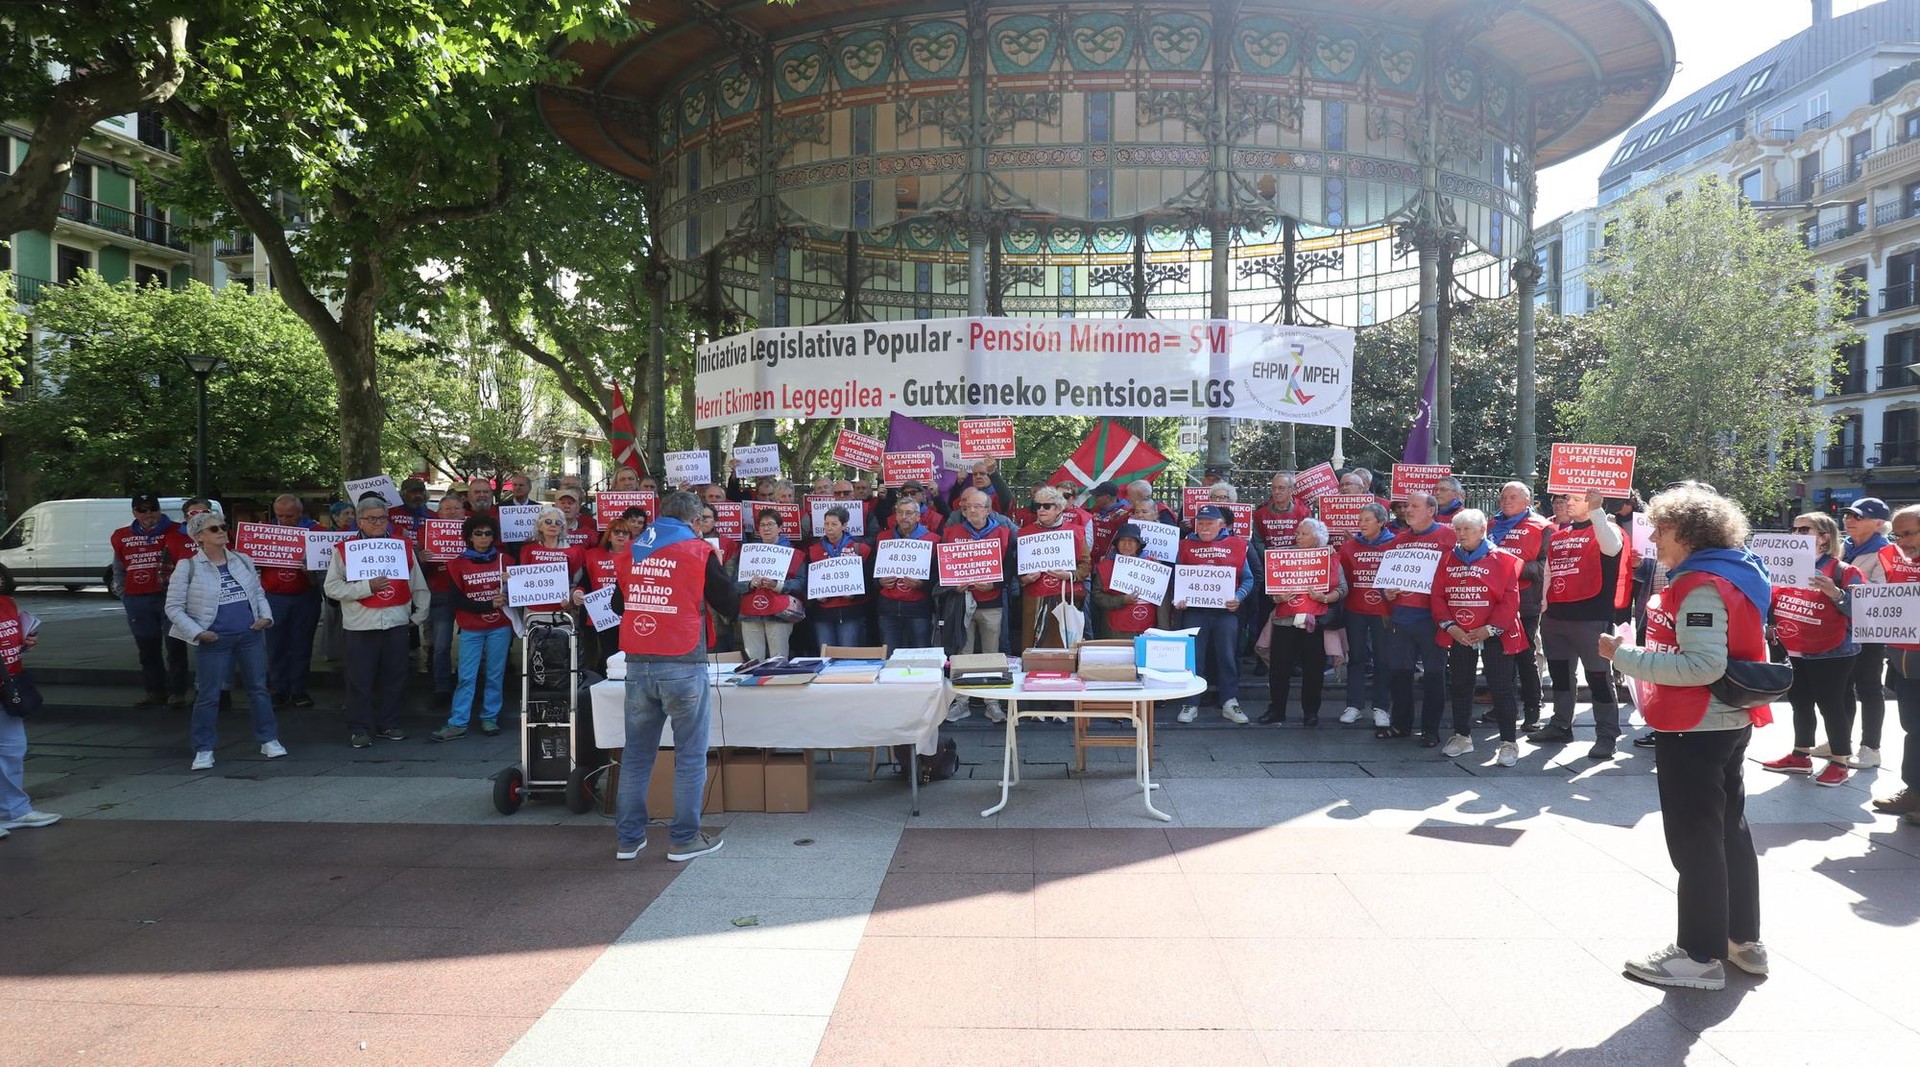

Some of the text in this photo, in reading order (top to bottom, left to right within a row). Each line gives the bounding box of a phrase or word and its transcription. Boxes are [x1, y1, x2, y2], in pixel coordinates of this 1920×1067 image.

[697, 340, 747, 374] Iniciativa
[750, 329, 857, 368] Legislativa
[863, 324, 953, 363] Popular
[969, 321, 1062, 357] Pensión
[1252, 362, 1340, 384] EHPM MPEH
[696, 397, 723, 421] Herri
[726, 388, 775, 415] Ekimen
[782, 379, 883, 416] Legegilea
[902, 375, 1047, 407] Gutxieneko
[962, 421, 1013, 429] GUTXIENEKO
[970, 427, 1007, 435] PENTSIOA
[843, 431, 884, 448] GUTXIENEKO
[965, 438, 1012, 446] GUTXIENEKO
[736, 446, 777, 455] GIPUZKOAN
[848, 439, 878, 452] PENTSIOA
[666, 452, 708, 462] GIPUZKOAN
[840, 446, 879, 461] GUTXIENEKO
[1558, 446, 1633, 457] GUTXIENEKO
[745, 456, 769, 464] 48.039
[844, 453, 872, 465] SOLDATA
[1569, 455, 1623, 465] PENTSIOA
[738, 467, 780, 475] SINADURAK
[1397, 466, 1451, 474] GUTXIENEKO
[1558, 468, 1628, 479] GUTXIENEKO
[347, 478, 389, 491] GIPUZKOA
[669, 474, 709, 484] SINADURAK
[1567, 476, 1616, 486] SOLDATA
[600, 493, 653, 501] GUTXIENEKO
[244, 525, 307, 537] GUTXIENEKO
[253, 533, 299, 543] PENTSIOA
[1019, 532, 1072, 545] GIPUZKOAN
[1143, 537, 1168, 547] 8.039
[244, 542, 303, 553] GUTXIENEKO
[349, 542, 403, 552] GIPUZKOA
[880, 541, 930, 550] GIPUZKOAN
[942, 541, 999, 553] GUTXIENEKO
[1752, 538, 1809, 551] GIPUZKOA
[251, 551, 294, 560] SOLDATA
[743, 545, 792, 557] GIPUZKOAN
[952, 548, 993, 559] PENTSIOA
[1031, 546, 1060, 555] 48.039
[1190, 547, 1231, 555] GUTXIENEKO
[1270, 550, 1328, 559] GUTXIENEKO
[1385, 550, 1439, 561] GIPUZKOAN
[361, 555, 396, 564] 48.039
[749, 557, 776, 565] 48.039
[888, 553, 917, 562] 48.039
[1280, 558, 1322, 566] PENTSIOA
[1763, 556, 1793, 567] 8.039
[509, 564, 566, 576] GIPUZKOAN
[810, 558, 860, 572] GIPUZKOAN
[945, 560, 999, 570] GUTXIENEKO
[1019, 559, 1074, 570] SINADURAK
[1117, 556, 1170, 576] GIPUZKOAN
[1391, 564, 1421, 573] 48.039
[359, 568, 400, 578] FIRMAS
[631, 564, 671, 578] MÍNIMA
[740, 570, 784, 580] SINADURAK
[820, 571, 849, 581] 48.039
[876, 566, 928, 577] SINADURAK
[953, 567, 992, 577] SOLDATA
[1179, 568, 1232, 579] GIPUZKOA
[1272, 569, 1326, 578] GUTXIENEKO
[523, 578, 554, 588] 48.039
[1127, 571, 1156, 585] 48.039
[1281, 576, 1319, 585] SOLDATA
[1375, 576, 1432, 590] SINADURAK
[628, 584, 673, 596] SALARIO
[809, 583, 862, 595] SINADURAK
[1112, 579, 1163, 602] SINADURAK
[1188, 583, 1221, 592] 48.039
[1854, 585, 1920, 599] GIPUZKOAN
[511, 592, 568, 604] SINADURAK
[628, 593, 669, 605] MÍNIMO
[1185, 596, 1224, 606] FIRMAS
[1865, 606, 1903, 618] 48.039
[1854, 626, 1917, 639] SINADURAK
